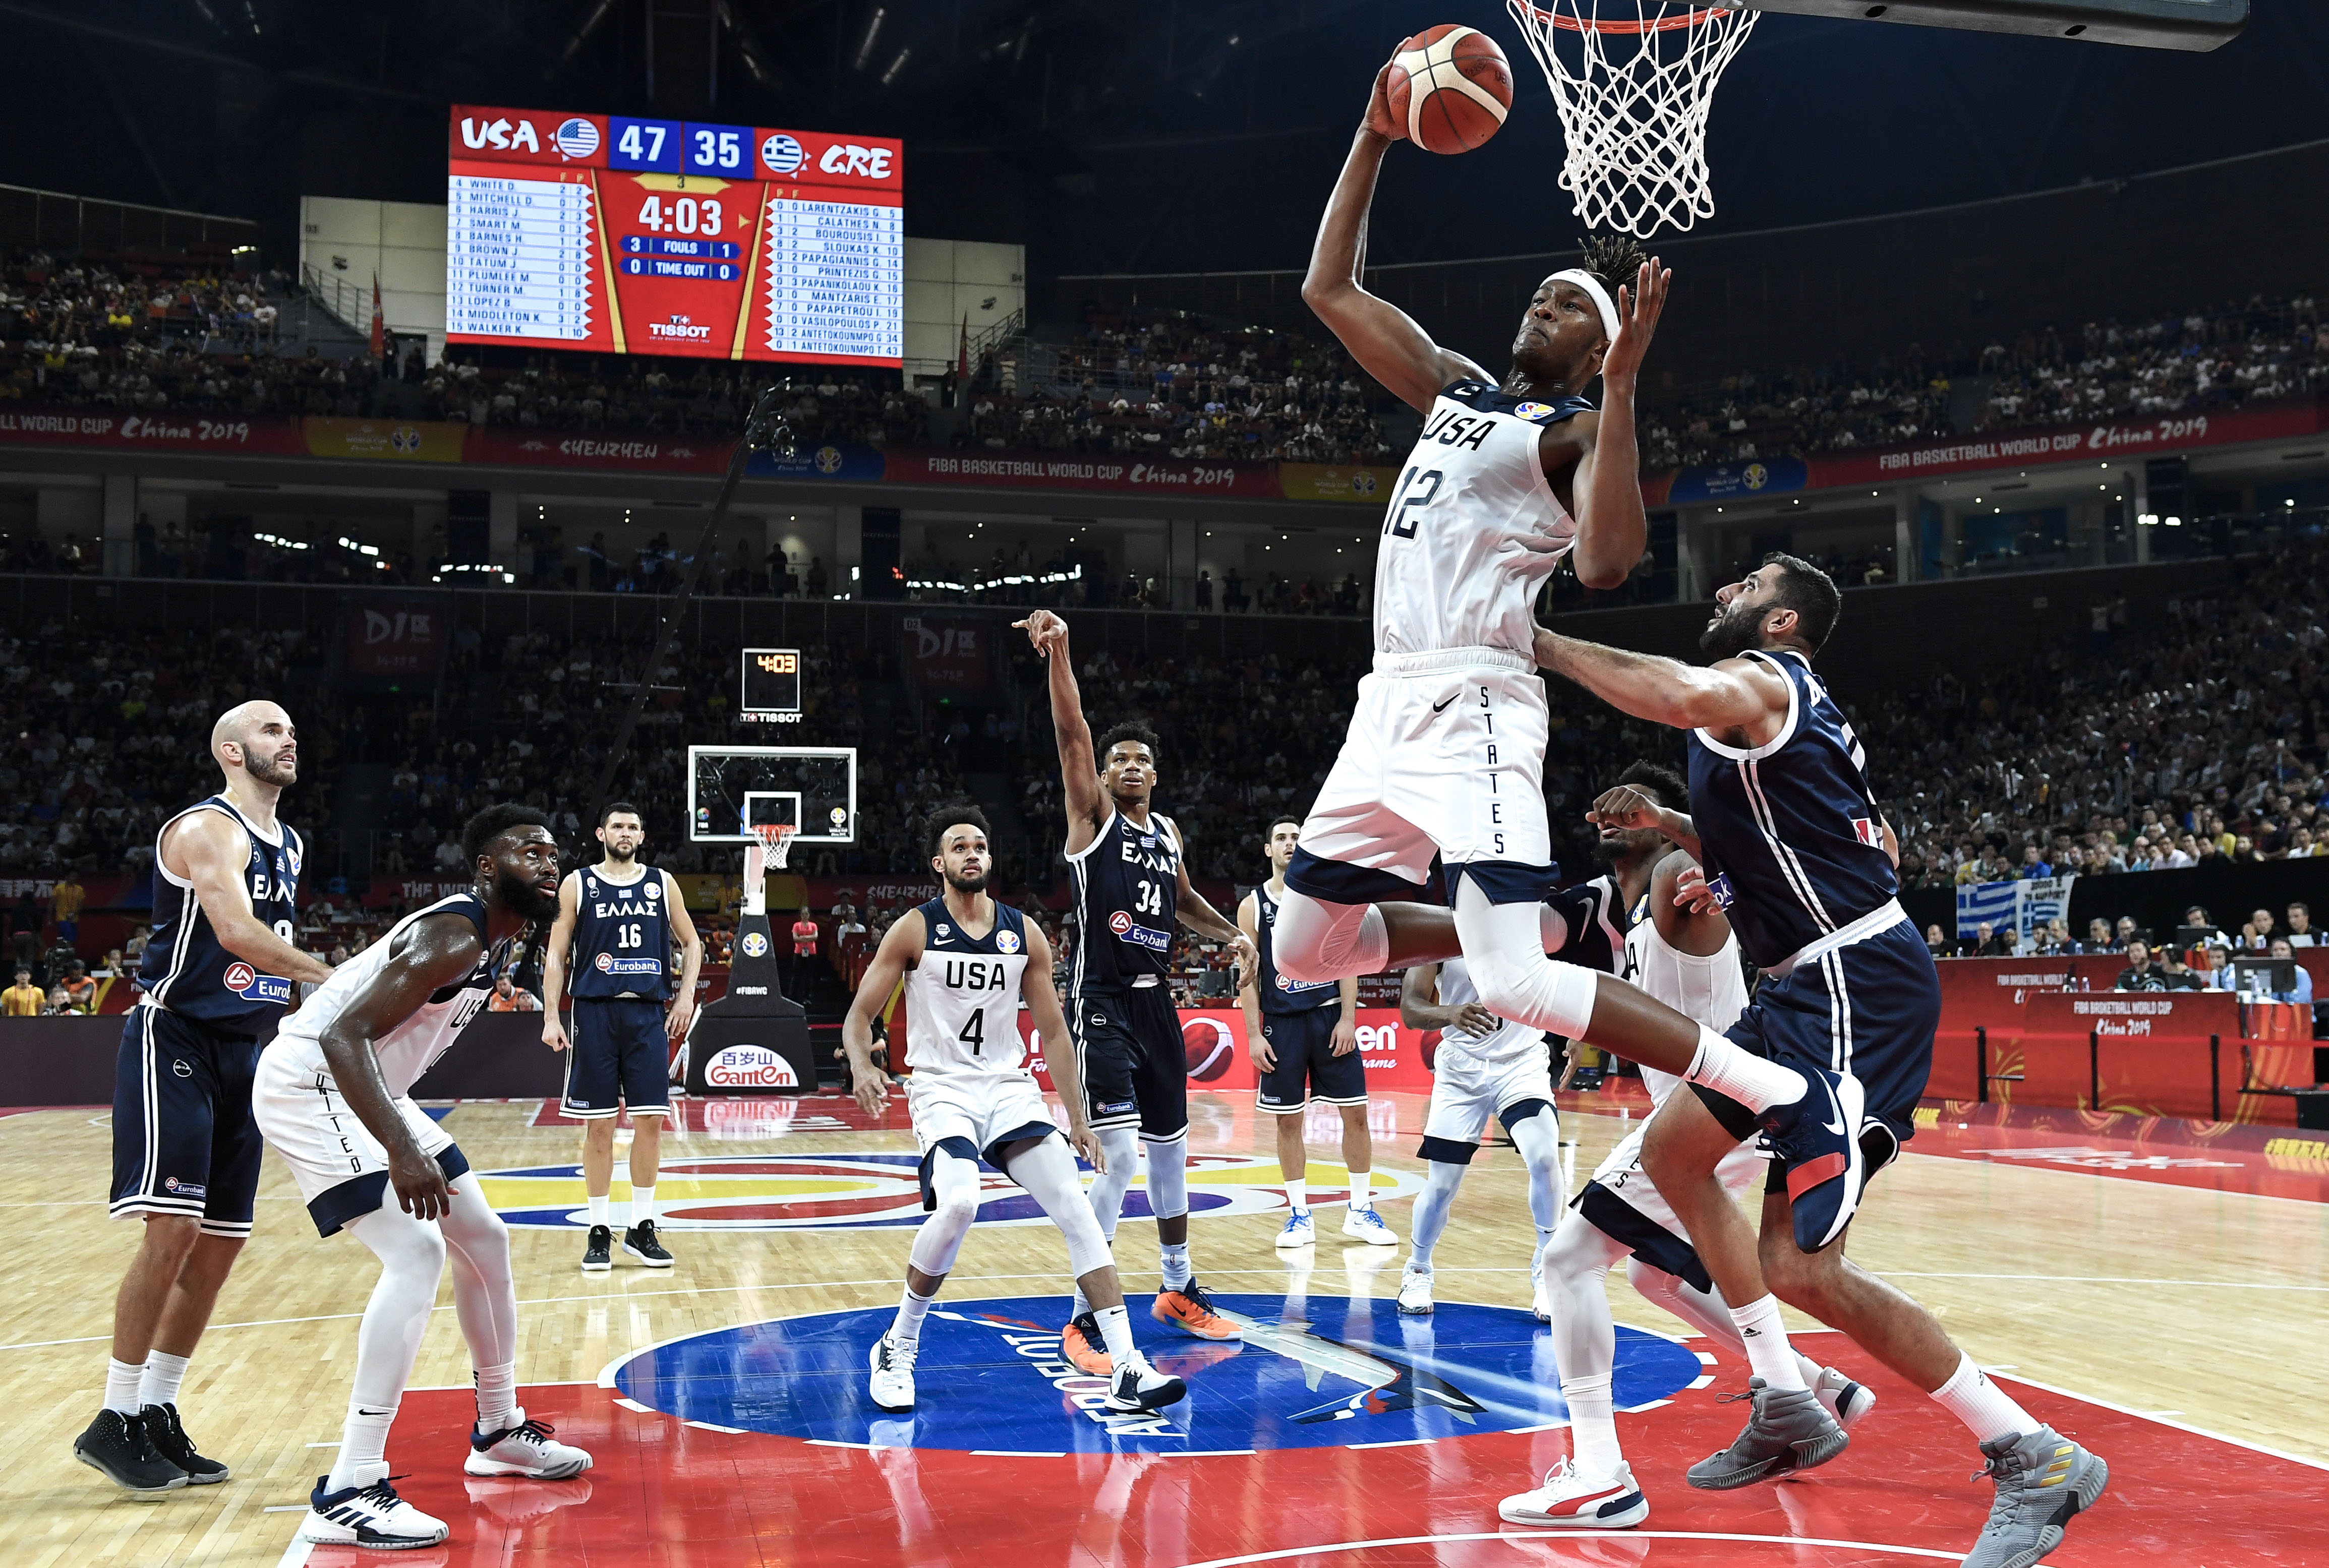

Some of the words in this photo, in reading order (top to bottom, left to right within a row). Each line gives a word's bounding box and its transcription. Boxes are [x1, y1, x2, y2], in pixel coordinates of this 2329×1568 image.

[461, 117, 539, 153] USA
[619, 125, 666, 162] 47
[695, 131, 740, 167] 35
[820, 144, 892, 179] GRE
[470, 180, 502, 189] WHITE
[560, 185, 565, 193] 2
[470, 194, 521, 204] MITCHELL
[560, 198, 565, 206] 0
[470, 206, 508, 216] HARRIS
[639, 196, 722, 235] 4:03
[777, 201, 783, 209] 0
[792, 202, 797, 210] 0
[802, 203, 869, 216] LARENTZAKIS
[470, 219, 507, 228] SMART
[818, 217, 869, 228] CALATHES
[469, 231, 511, 242] BARNES
[816, 229, 872, 242] BOUROUSIS
[469, 245, 508, 255] BROWN
[630, 237, 641, 252] 3
[664, 240, 697, 254] FOULS
[722, 244, 729, 258] 1
[824, 242, 869, 253] SLOUKAS
[470, 258, 507, 267] TATUM
[559, 263, 564, 271] 0
[575, 264, 580, 272] 0
[777, 252, 782, 260] 0
[802, 254, 869, 266] PAPAGIANNIS
[630, 259, 641, 274] 0
[656, 262, 682, 275] TIME
[684, 263, 706, 276] OUT
[720, 265, 729, 279] 0
[819, 267, 868, 278] PRINTEZIS
[469, 271, 515, 281] PLUMLEE
[559, 275, 564, 284] 0
[575, 277, 580, 285] 0
[470, 283, 510, 294] TURNER
[777, 289, 782, 297] 0
[792, 290, 797, 298] 0
[811, 291, 870, 304] MANTZARIS
[469, 297, 500, 307] LOPEZ
[558, 302, 564, 310] 0
[574, 303, 580, 311] 0
[792, 303, 797, 311] 0
[807, 305, 872, 316] PAPAPETROU
[468, 310, 529, 321] MIDDLETON
[777, 315, 782, 323] 0
[792, 316, 797, 324] 0
[801, 317, 870, 329] VASILOPOULOS
[468, 323, 511, 333] WALKER
[573, 329, 582, 337] 10
[649, 323, 711, 338] TISSOT
[801, 330, 873, 341] ANTETOKOUNMPO
[777, 341, 782, 349] 0
[801, 342, 874, 354] ANTETOKOUNMPO
[20, 415, 76, 433] WORLD
[81, 417, 113, 435] CUP
[120, 416, 191, 439] China
[198, 419, 249, 444] 2019
[1421, 409, 1497, 451] USA
[559, 440, 658, 459] SHENZHEN
[1880, 452, 1910, 470] FIBA
[1913, 444, 1998, 466] BASKETBALL
[2000, 437, 2050, 457] WORLD
[2053, 434, 2081, 451] CUP
[2088, 427, 2153, 450] China
[2158, 415, 2208, 441] 2019
[928, 457, 958, 473] FIBA
[962, 459, 1045, 477] BASKETBALL
[1047, 463, 1094, 479] WORLD
[1097, 465, 1123, 479] CUP
[1129, 463, 1188, 485] China
[1192, 466, 1235, 488] 2019
[1383, 466, 1445, 541] 12
[758, 655, 796, 673] 4:03
[758, 713, 803, 723] TISSOT
[1480, 686, 1504, 855] STATES
[1135, 880, 1161, 916] 34
[595, 901, 657, 918] ΕΛΛΑΣ
[618, 924, 642, 948] 16
[614, 961, 657, 971] Eurobank
[946, 960, 1006, 991] USA
[696, 980, 711, 989] CUP
[736, 986, 768, 995] #FIBAWC
[1379, 988, 1401, 998] 2019
[2089, 1001, 2131, 1014] BASKETBALL
[2132, 1001, 2157, 1015] WORLD
[2158, 1001, 2173, 1015] CUP
[959, 1008, 984, 1055] 4
[2095, 1018, 2126, 1035] China
[2127, 1018, 2151, 1037] 2019
[722, 1052, 772, 1065] 百岁山
[1362, 1059, 1398, 1069] ame
[1107, 1104, 1131, 1112] Eurobank
[316, 1073, 361, 1173] UNITED
